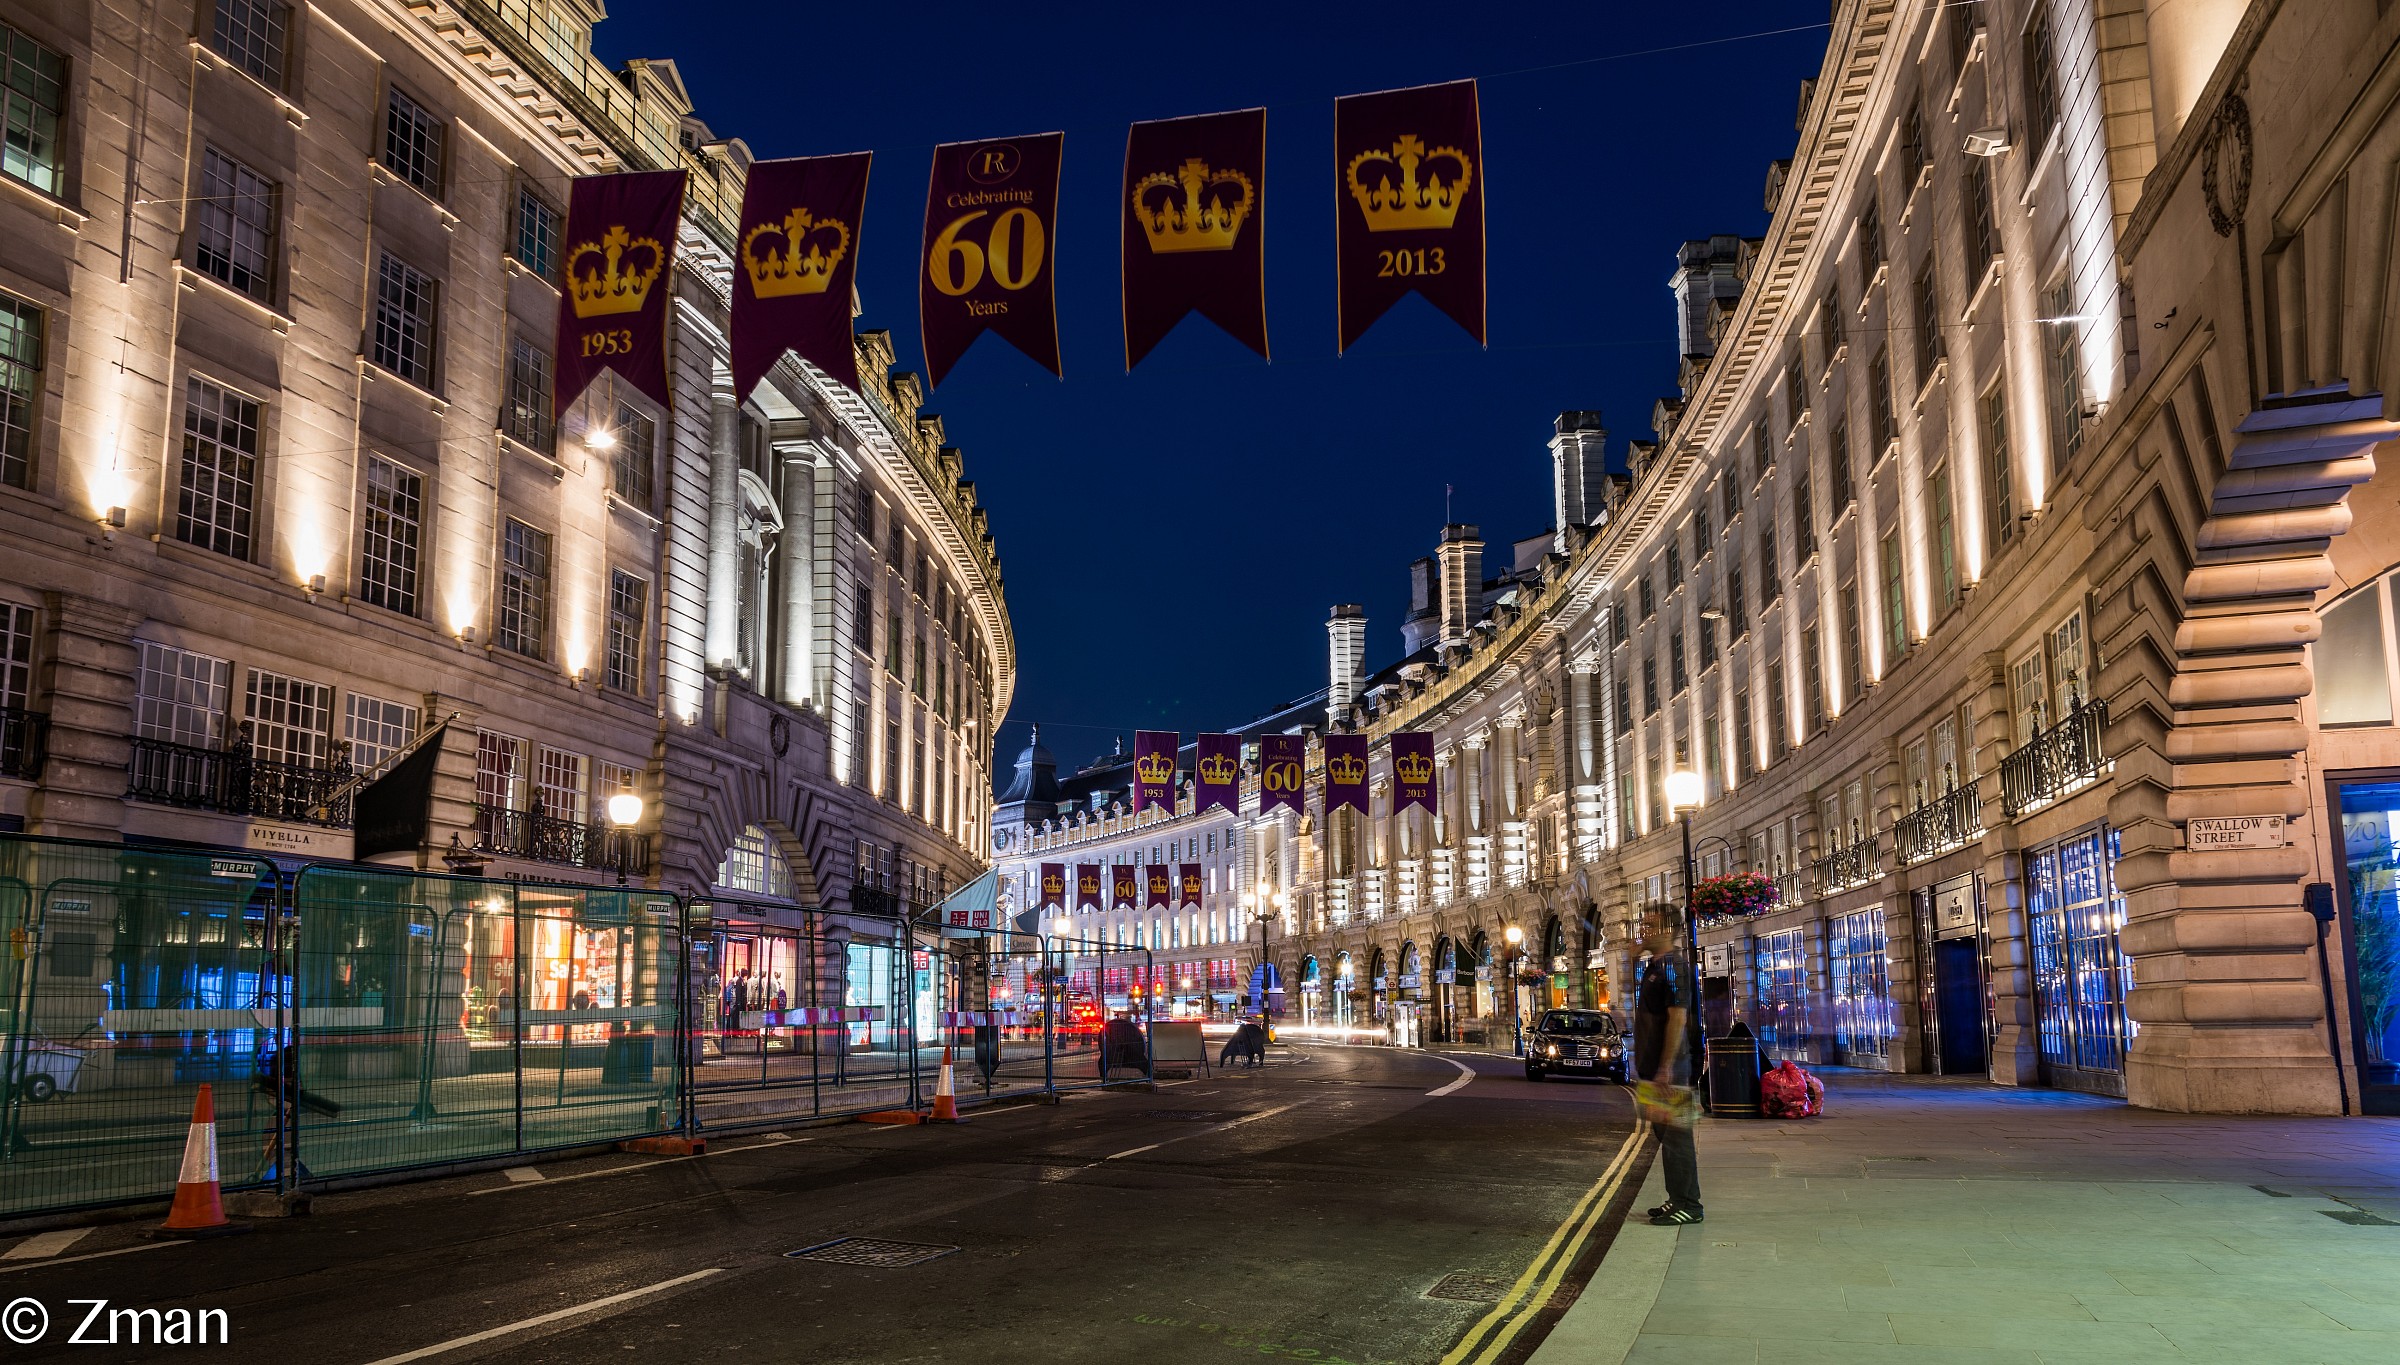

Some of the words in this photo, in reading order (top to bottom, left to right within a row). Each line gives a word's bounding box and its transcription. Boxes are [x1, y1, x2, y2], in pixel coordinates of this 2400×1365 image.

[947, 188, 1034, 208] Celebrating
[929, 207, 1045, 296] 60
[1377, 247, 1446, 278] 2013
[965, 301, 1009, 317] Years
[580, 329, 633, 357] 1953
[1268, 754, 1298, 762] Celebrating
[1263, 762, 1303, 792] 60
[1143, 788, 1164, 798] 1953
[1405, 788, 1427, 798] 2013
[2195, 818, 2263, 831] SWALLOW
[253, 829, 310, 844] VIYELLA
[2195, 832, 2245, 843] STREET
[213, 862, 256, 873] MURPHY
[1115, 881, 1136, 898] 60
[52, 902, 90, 911] MURPHY
[974, 911, 988, 919] UNI
[973, 919, 988, 928] QLO
